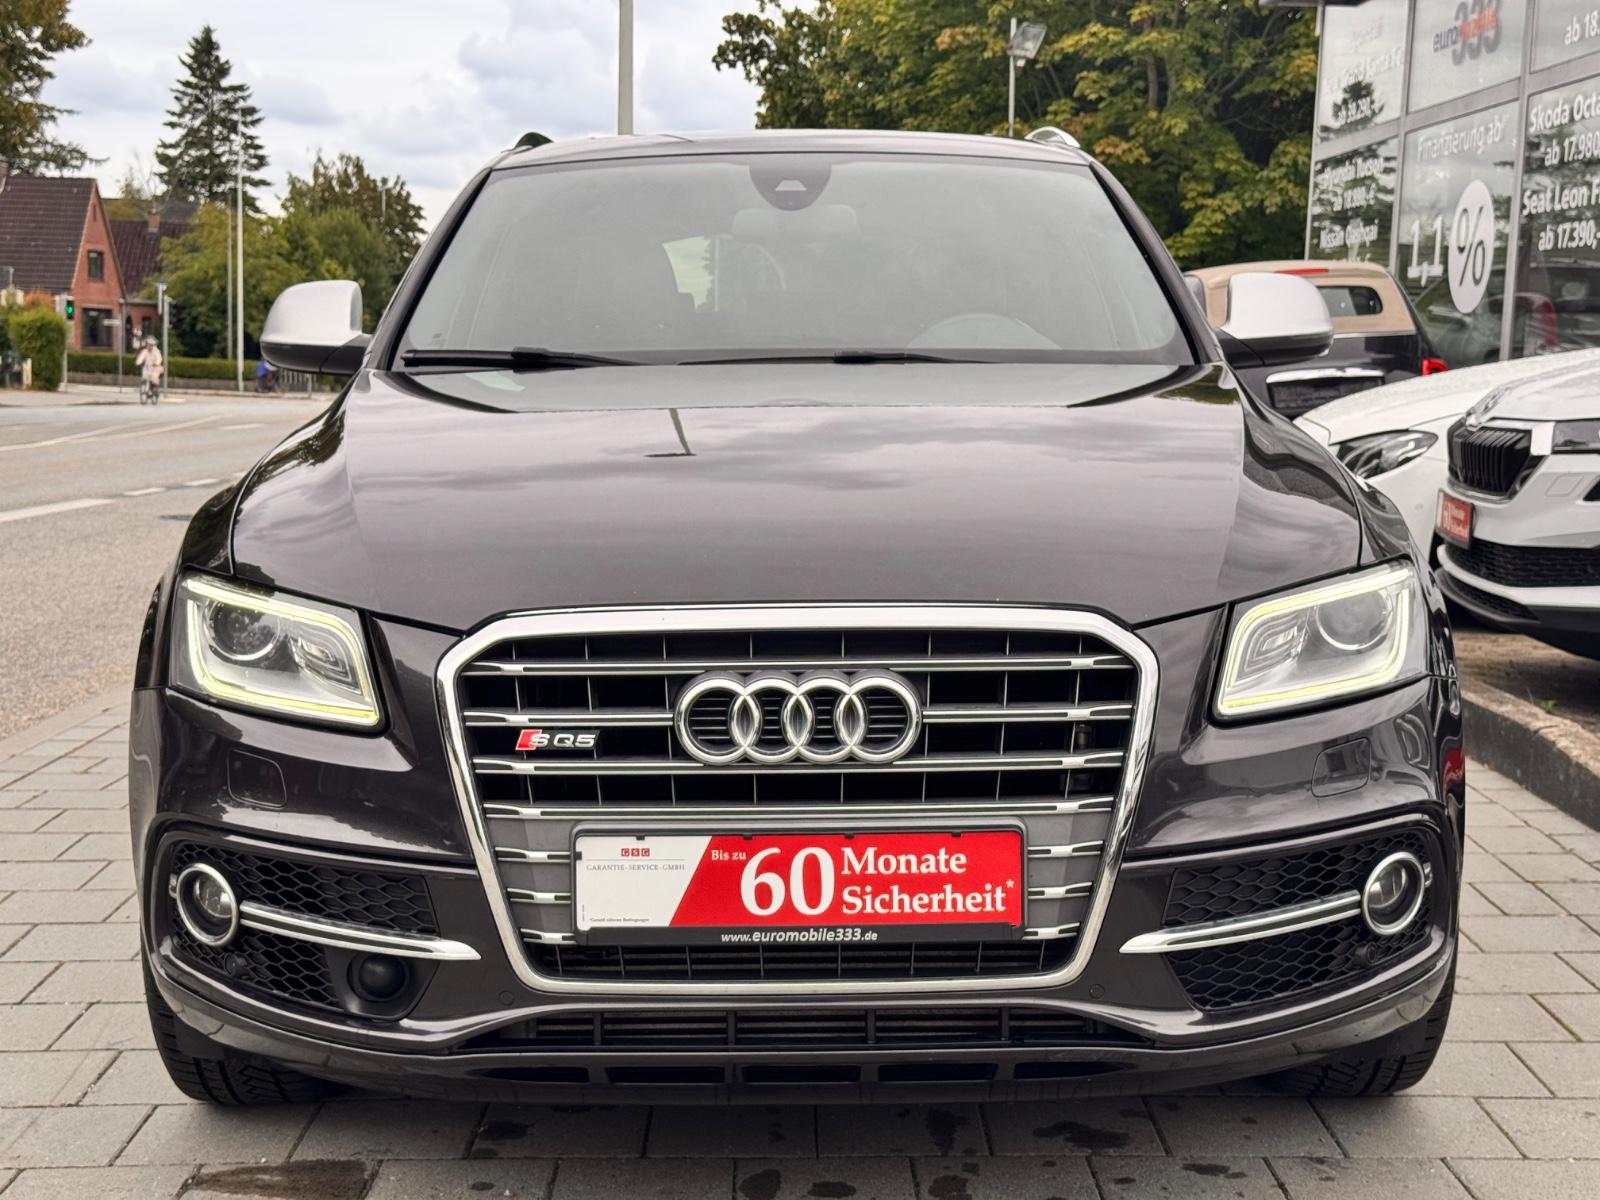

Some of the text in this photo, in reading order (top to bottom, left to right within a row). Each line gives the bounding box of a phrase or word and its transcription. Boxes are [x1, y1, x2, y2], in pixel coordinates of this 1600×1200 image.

[1564, 15, 1580, 45] ab
[1530, 97, 1569, 133] Skoda
[1416, 121, 1485, 162] Finanzierung
[1544, 138, 1560, 167] ab
[1522, 184, 1552, 217] Seat
[1553, 181, 1588, 211] Leon
[1538, 223, 1554, 251] ab
[711, 849, 747, 861] Bis zu
[841, 847, 968, 876] Monate
[740, 846, 835, 917] 60
[721, 928, 878, 943] www.euromobile333.de
